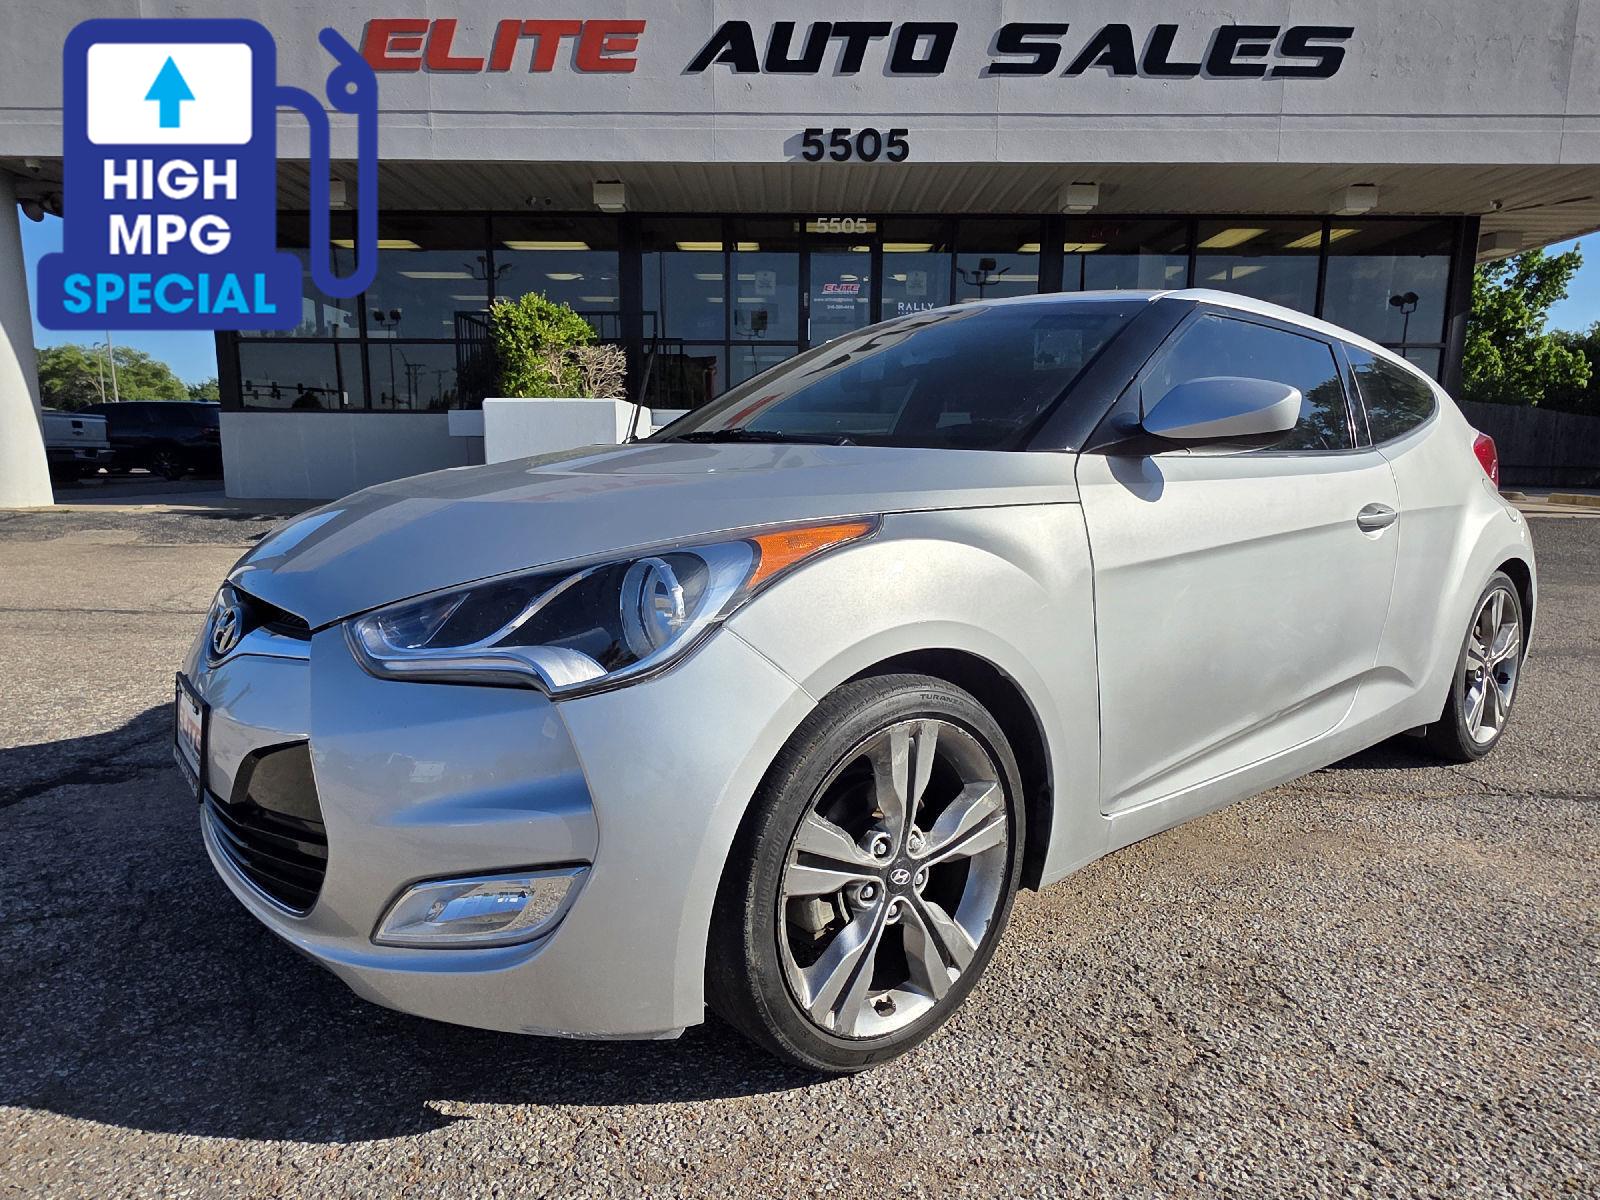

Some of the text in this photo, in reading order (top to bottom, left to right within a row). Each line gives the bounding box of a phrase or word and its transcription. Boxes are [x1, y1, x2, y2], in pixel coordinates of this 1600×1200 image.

[364, 19, 1355, 78] ELITE AUTO SALES
[802, 128, 909, 162] 5505
[817, 217, 868, 234] 5505
[823, 283, 861, 292] ELITE
[897, 302, 935, 311] RALLY
